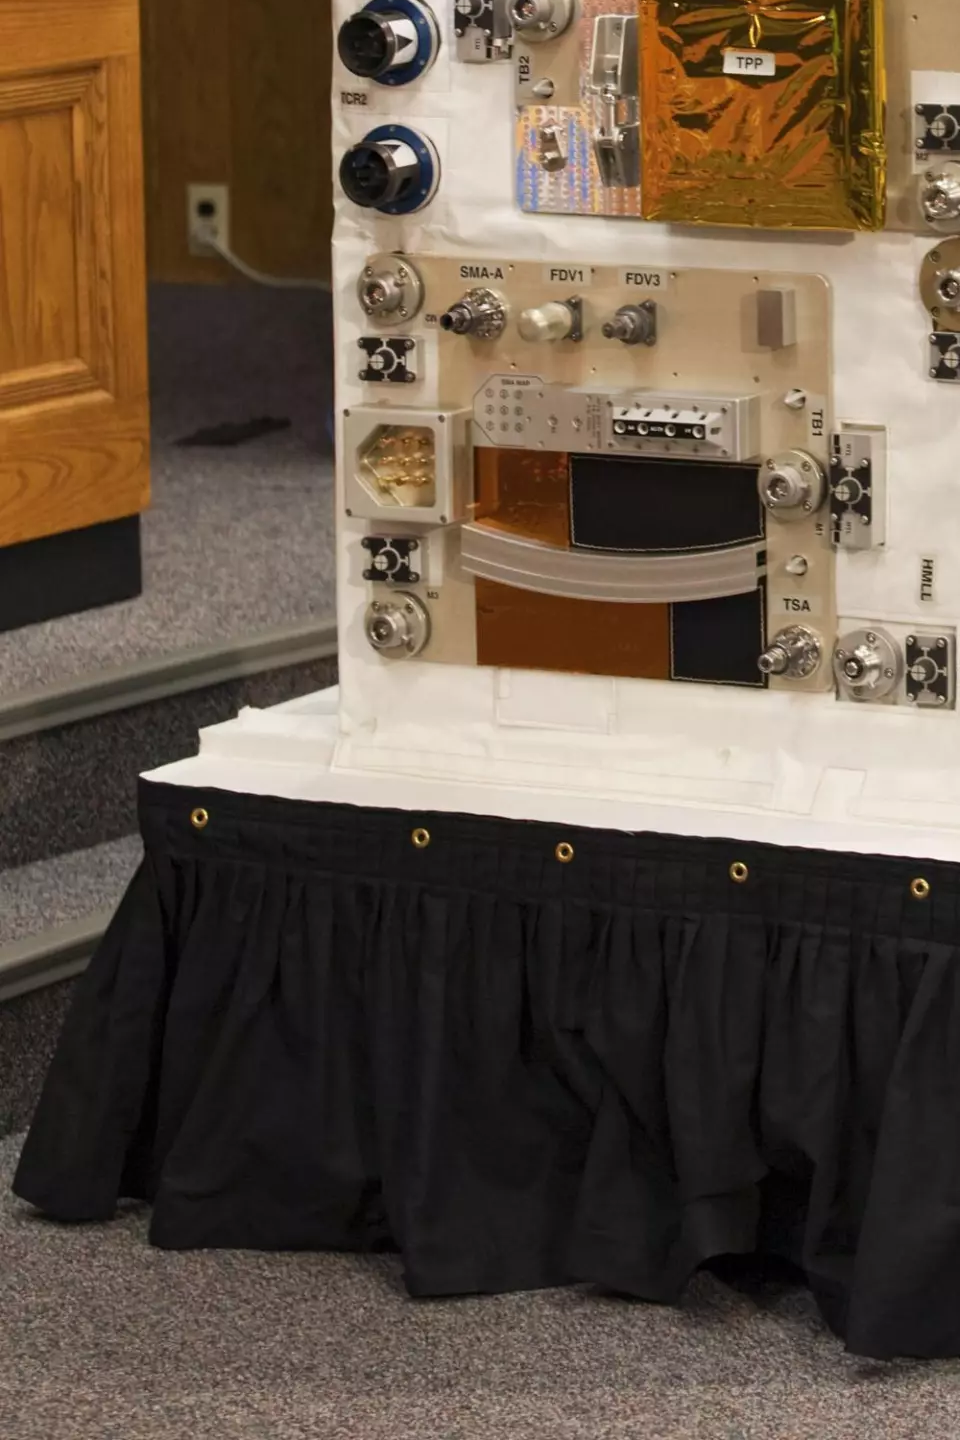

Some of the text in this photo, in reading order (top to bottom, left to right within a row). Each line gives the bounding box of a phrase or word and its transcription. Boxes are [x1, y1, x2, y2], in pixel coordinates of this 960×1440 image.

[519, 55, 531, 85] TB2
[736, 56, 764, 70] TPP
[340, 91, 368, 106] TCR2
[460, 265, 504, 280] SMA-A
[550, 268, 584, 282] FDV1
[626, 272, 661, 286] FDV3
[811, 409, 824, 437] TB1
[920, 558, 934, 601] HMLL
[782, 597, 811, 612] TSA
